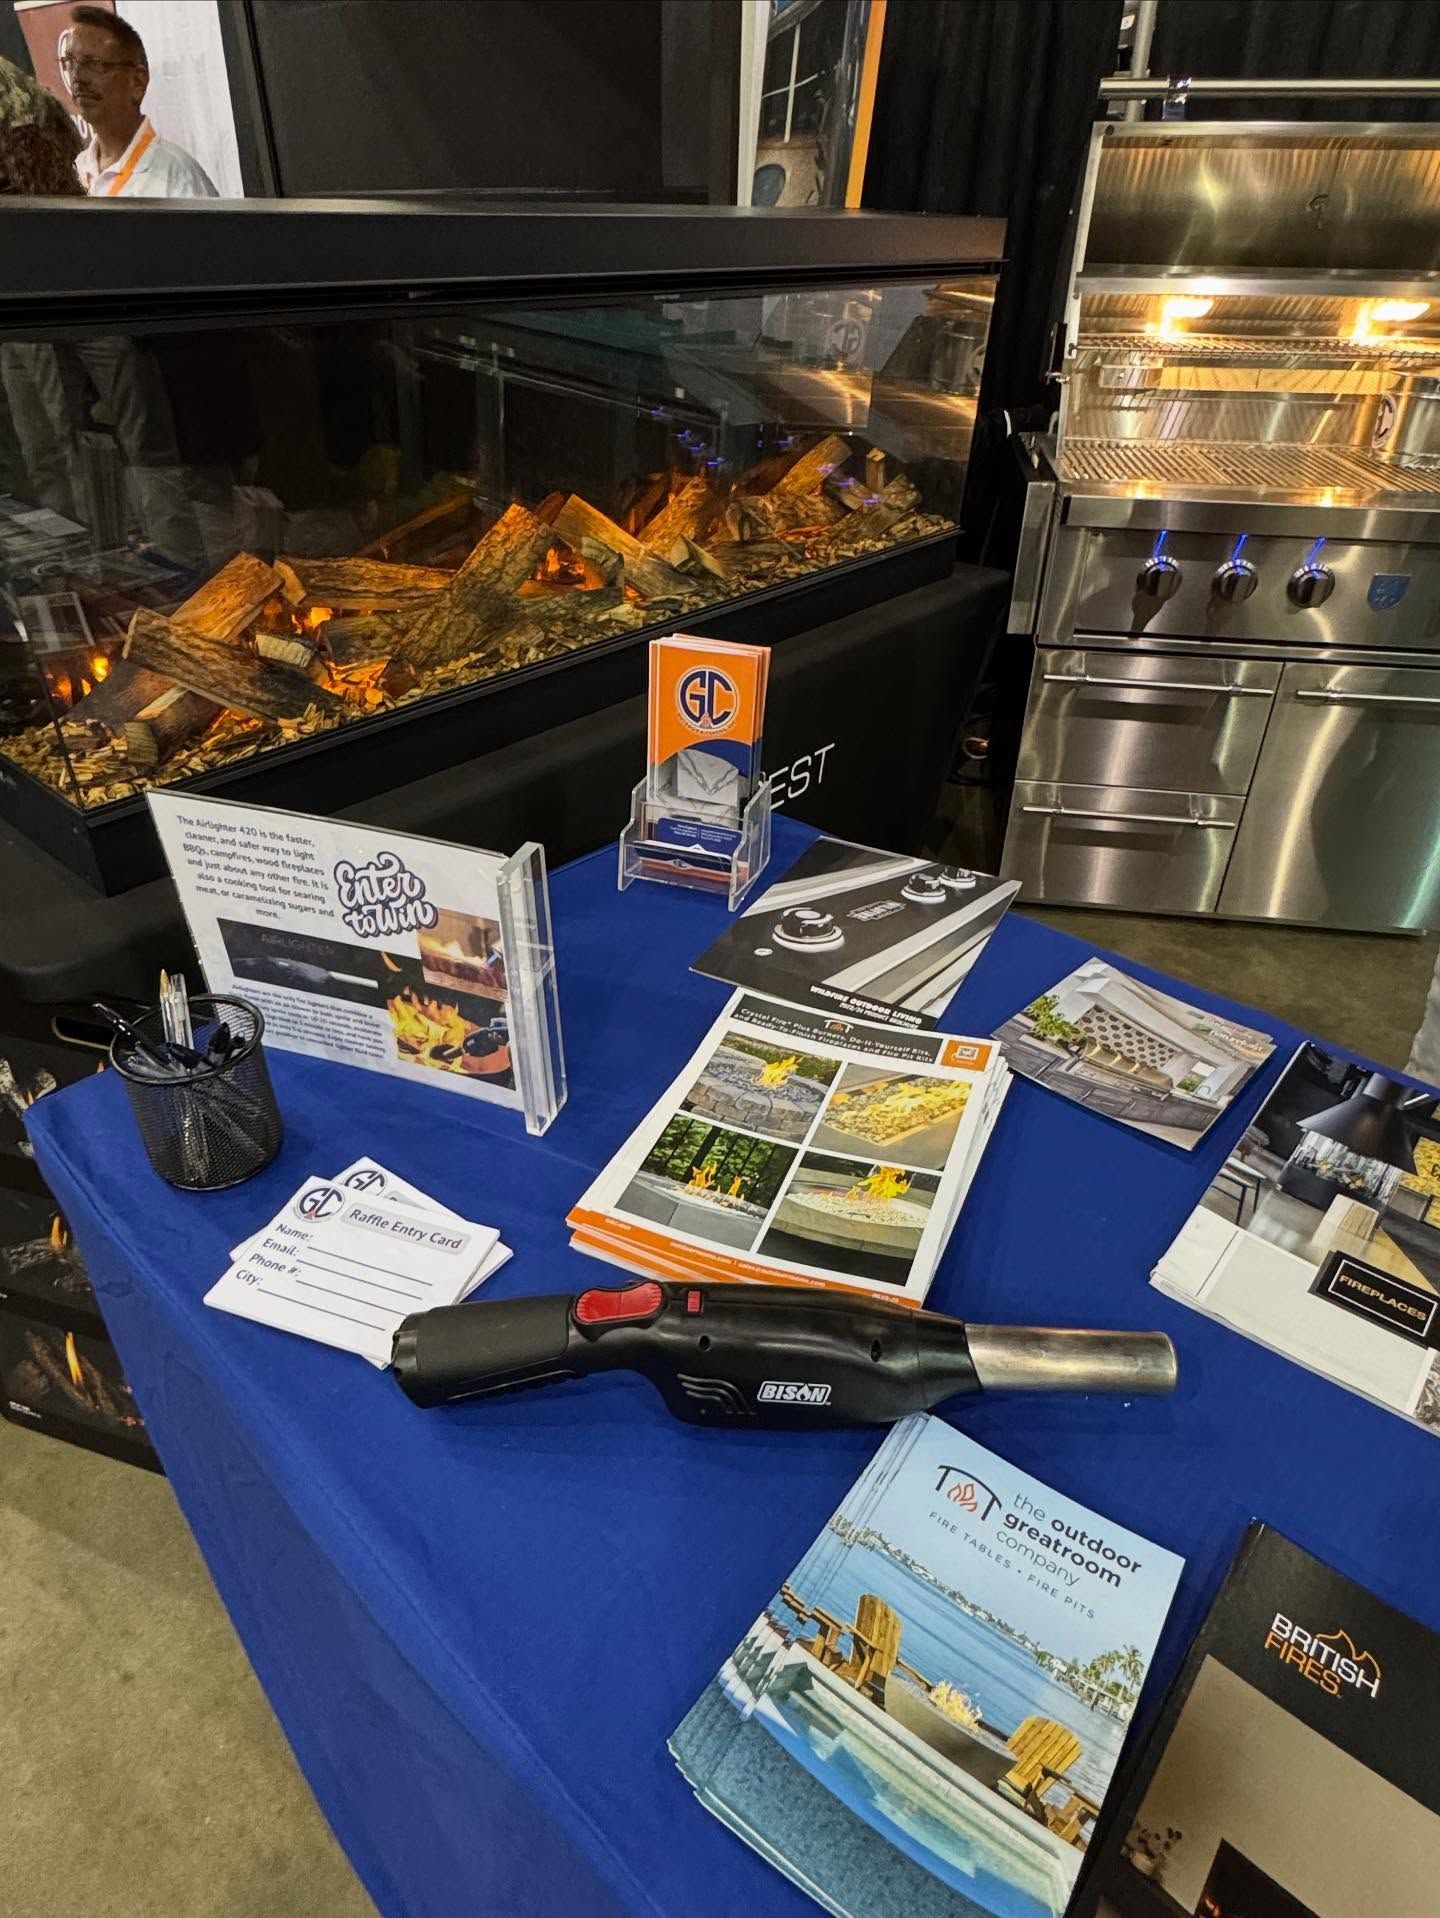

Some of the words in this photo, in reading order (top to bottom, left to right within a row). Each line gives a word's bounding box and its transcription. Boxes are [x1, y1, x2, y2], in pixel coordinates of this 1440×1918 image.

[680, 671, 733, 726] GC
[758, 743, 836, 811] EST
[176, 815, 194, 825] The
[196, 819, 236, 832] Airlighter
[239, 826, 257, 836] 420
[259, 829, 267, 838] is
[269, 832, 283, 841] the
[210, 850, 255, 863] campfires,
[256, 858, 279, 867] wood
[281, 860, 325, 875] fireplaces
[221, 838, 236, 846] and
[239, 841, 259, 849] safer
[262, 845, 279, 855] way
[293, 849, 315, 860] light
[188, 859, 203, 867] and
[205, 860, 221, 870] just
[223, 864, 247, 875] about
[250, 870, 265, 879] any
[267, 873, 290, 882] other
[321, 881, 328, 890] is
[197, 873, 215, 881] also
[224, 878, 258, 891] cooking
[259, 884, 276, 893] tool
[278, 887, 291, 895] for
[293, 891, 326, 904] searing
[334, 851, 426, 908] Enter
[232, 892, 286, 909] caramelizing
[288, 903, 316, 913] sugars
[318, 909, 334, 917] and
[342, 910, 380, 938] to
[362, 894, 438, 937] Win
[810, 985, 849, 1002] WILDFIRE
[849, 998, 891, 1015] OUTDOOR
[892, 1011, 922, 1024] LIVING
[864, 1009, 889, 1021] PRODUCT
[733, 1013, 749, 1021] and
[751, 1016, 817, 1039] Ready-To-Finish
[818, 1036, 861, 1050] Fireplaces
[863, 1046, 880, 1054] and
[882, 1049, 899, 1057] Fire
[741, 1008, 770, 1020] Crystal
[793, 1023, 811, 1032] Plus
[849, 1036, 911, 1052] Do-It-Yourself
[300, 1187, 342, 1218] GC
[262, 1238, 300, 1256] Email:
[275, 1223, 313, 1241] Name:
[349, 1208, 389, 1228] Raffle
[391, 1221, 428, 1241] Entry
[429, 1232, 462, 1249] Card
[236, 1269, 263, 1285] City:
[249, 1253, 287, 1272] Phone
[287, 1266, 302, 1277] #:
[1339, 1274, 1427, 1321] FIREPLACES
[761, 1384, 827, 1402] BISON
[1003, 1513, 1122, 1588] greatroom
[1012, 1492, 1046, 1522] the
[1051, 1518, 1142, 1574] outdoor
[929, 1511, 959, 1534] FIRE
[963, 1533, 1012, 1569] TABLES
[1027, 1574, 1059, 1598] FIRE
[1064, 1596, 1095, 1620] PITS
[995, 1531, 1081, 1586] company
[1264, 1631, 1341, 1695] FIRES
[1271, 1612, 1380, 1698] BRITISH
